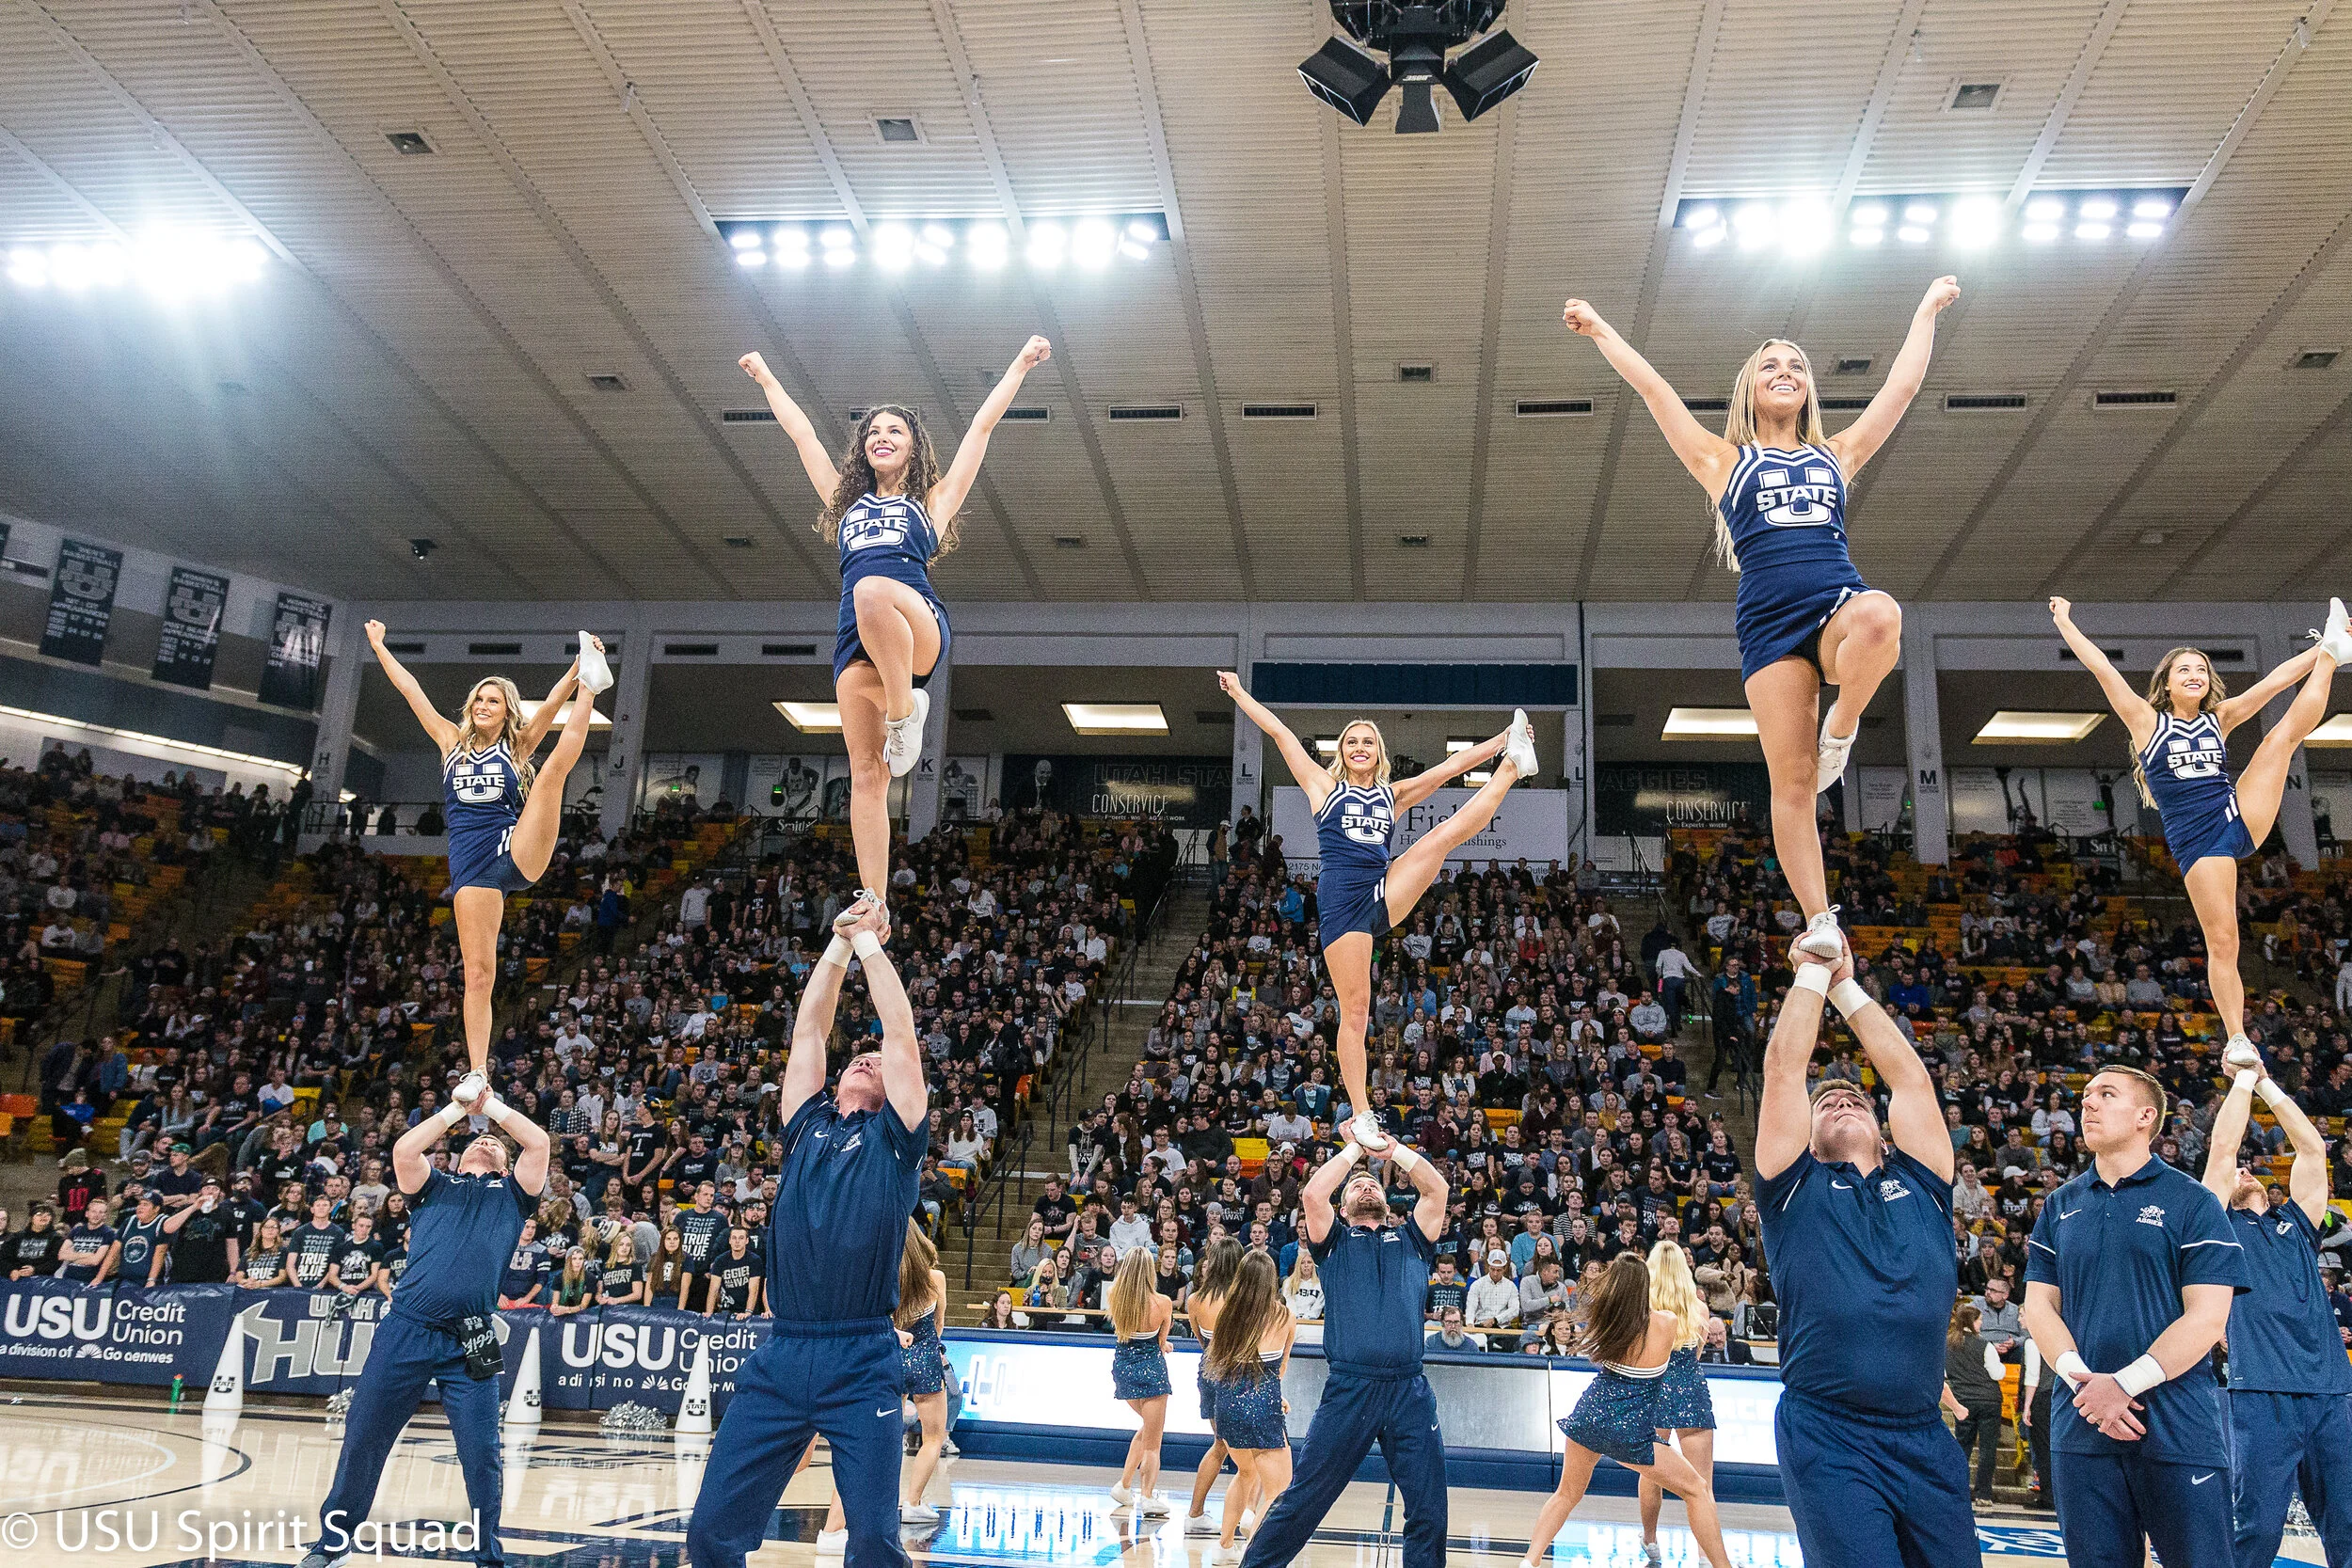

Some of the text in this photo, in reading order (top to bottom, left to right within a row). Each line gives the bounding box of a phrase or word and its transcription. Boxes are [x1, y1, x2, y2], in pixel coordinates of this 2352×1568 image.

[1756, 484, 1837, 513] STATE
[843, 517, 909, 543] STATE
[614, 755, 624, 768] J
[921, 758, 934, 772] K
[2167, 750, 2223, 769] STATE
[1094, 764, 1167, 786] UTAH
[1242, 763, 1252, 777] L
[1920, 770, 1936, 784] M
[453, 774, 505, 791] STATE
[1341, 815, 1391, 834] STATE
[1405, 804, 1502, 832] Fisr
[1288, 863, 1310, 871] 2175
[683, 1232, 712, 1245] TRUE
[300, 1252, 329, 1265] TRUE
[246, 1267, 273, 1279] TRUE
[733, 1276, 750, 1287] WA
[5, 1293, 113, 1341] USU
[116, 1299, 187, 1323] Credit
[112, 1323, 183, 1345] Union
[679, 1327, 757, 1351] Credit
[8, 1342, 57, 1358] division
[58, 1344, 74, 1357] of
[562, 1323, 676, 1370] USU
